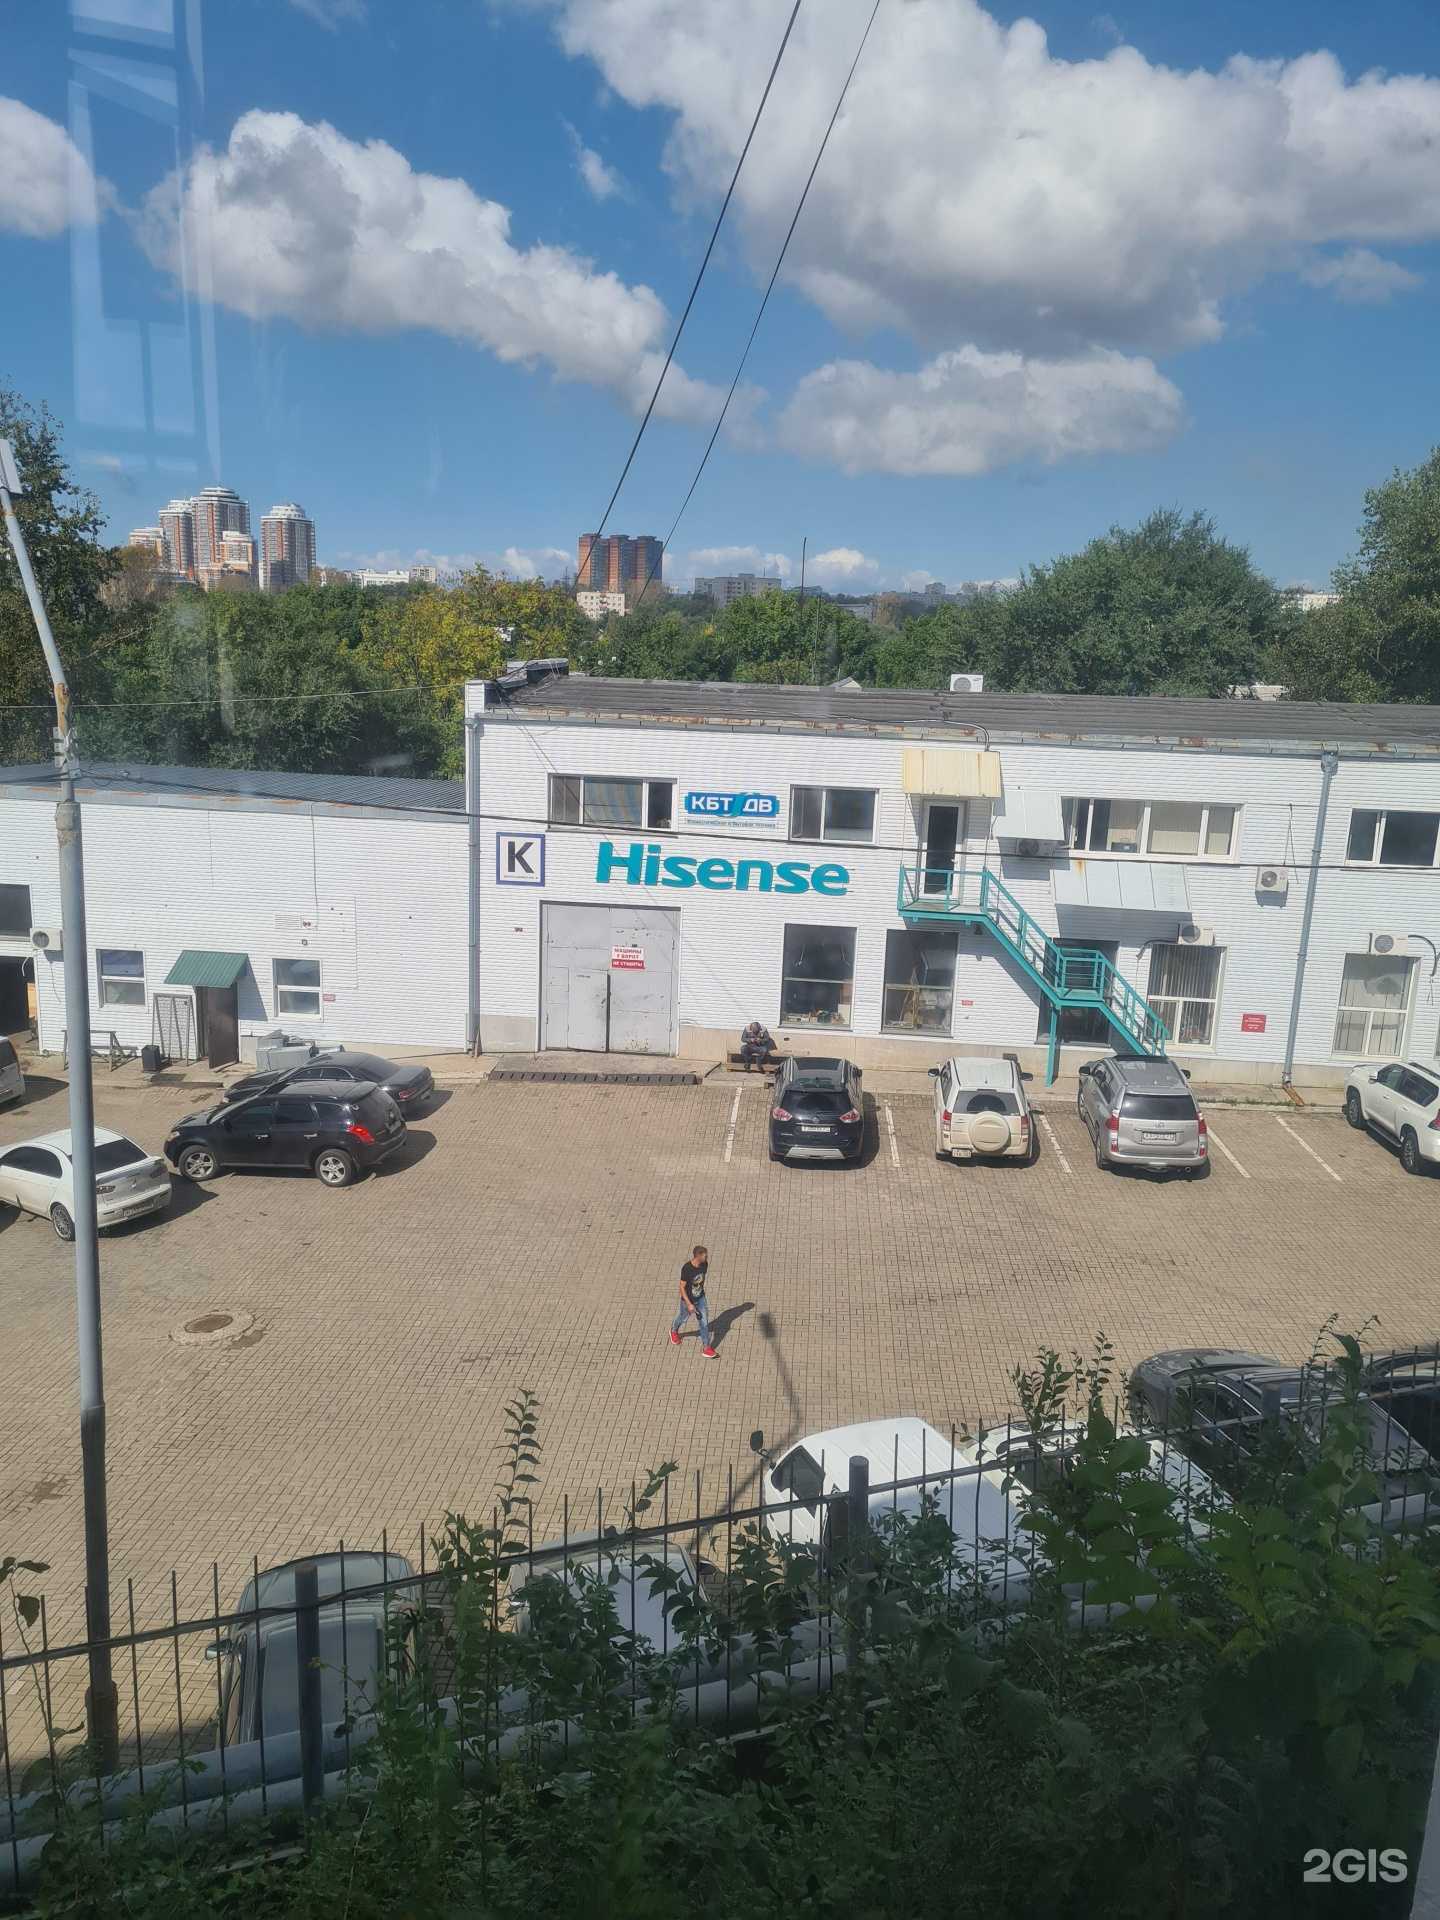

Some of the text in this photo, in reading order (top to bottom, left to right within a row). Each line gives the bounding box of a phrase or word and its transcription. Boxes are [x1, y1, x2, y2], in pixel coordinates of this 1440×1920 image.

[692, 796, 773, 813] КБТ ДВ
[596, 841, 849, 896] Hisense
